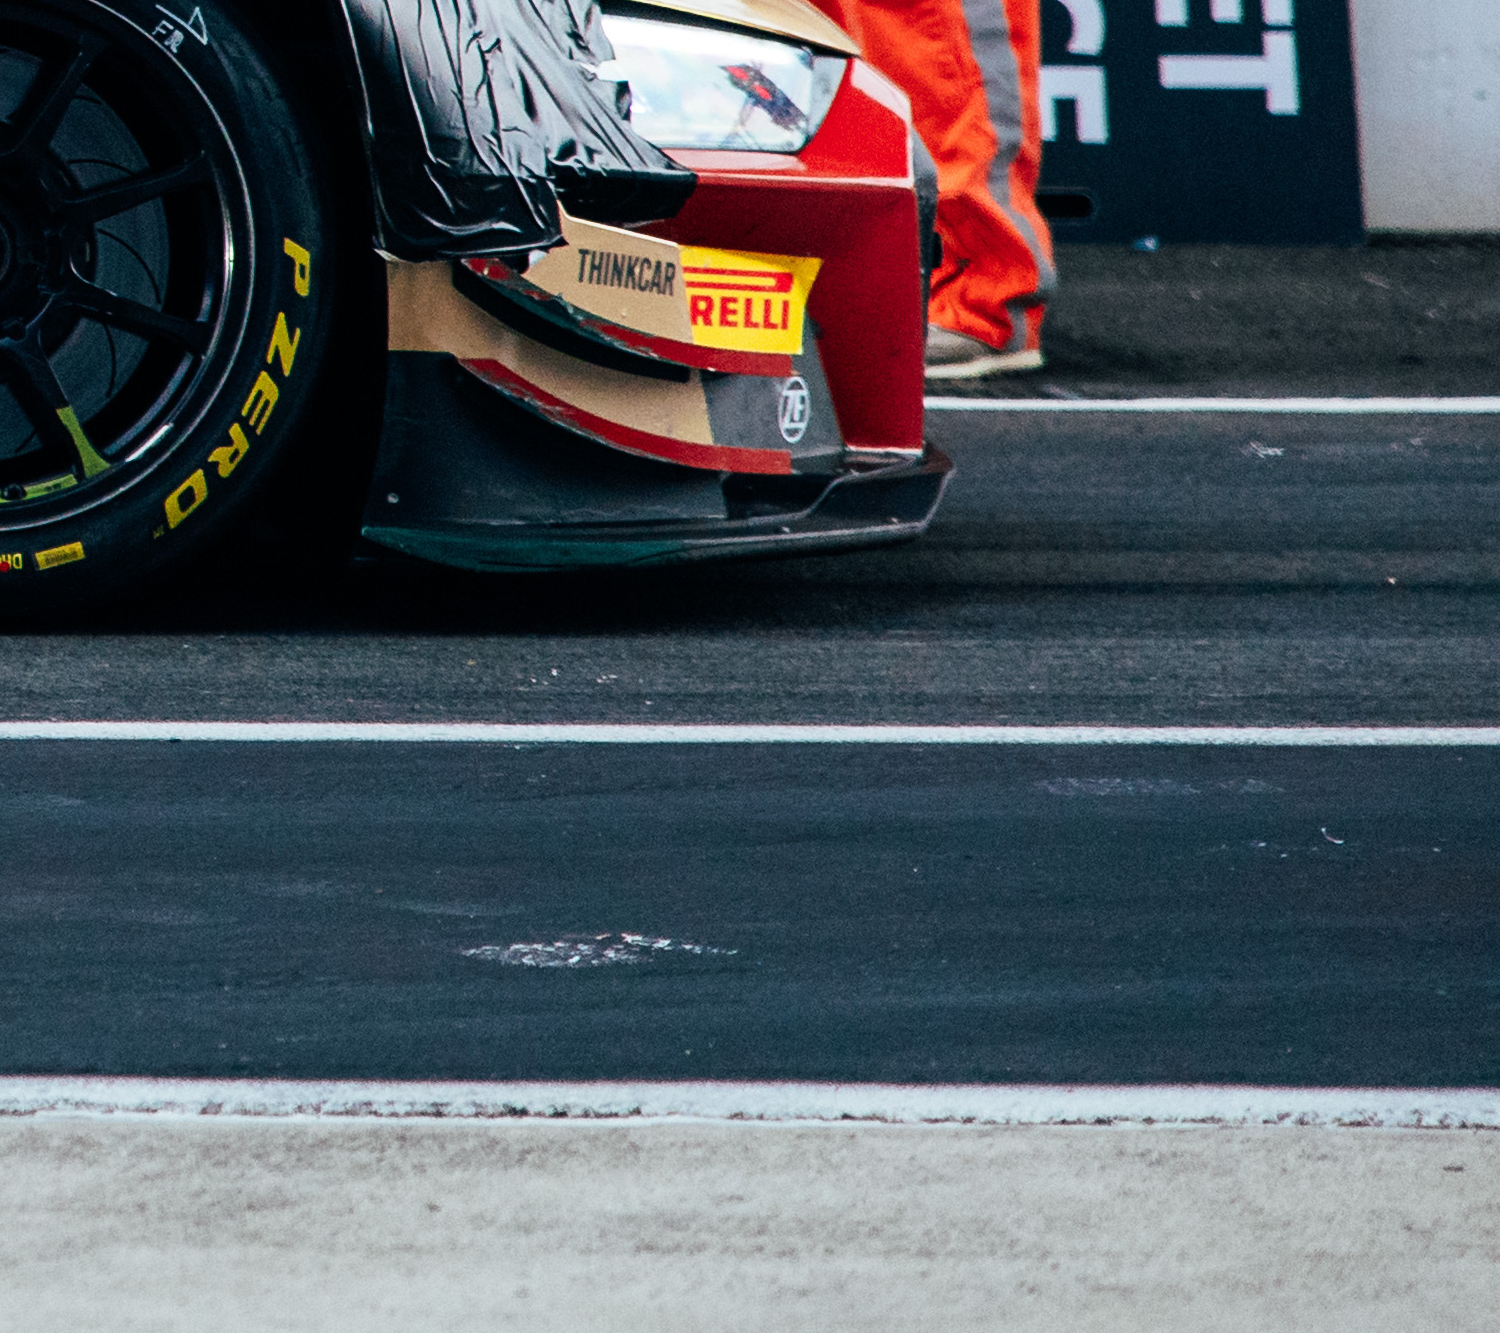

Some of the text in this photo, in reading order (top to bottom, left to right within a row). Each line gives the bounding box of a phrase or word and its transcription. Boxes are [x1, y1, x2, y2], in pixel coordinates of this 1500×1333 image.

[151, 19, 185, 54] FR
[578, 248, 677, 297] THINKCAR
[163, 311, 302, 530] ZERO
